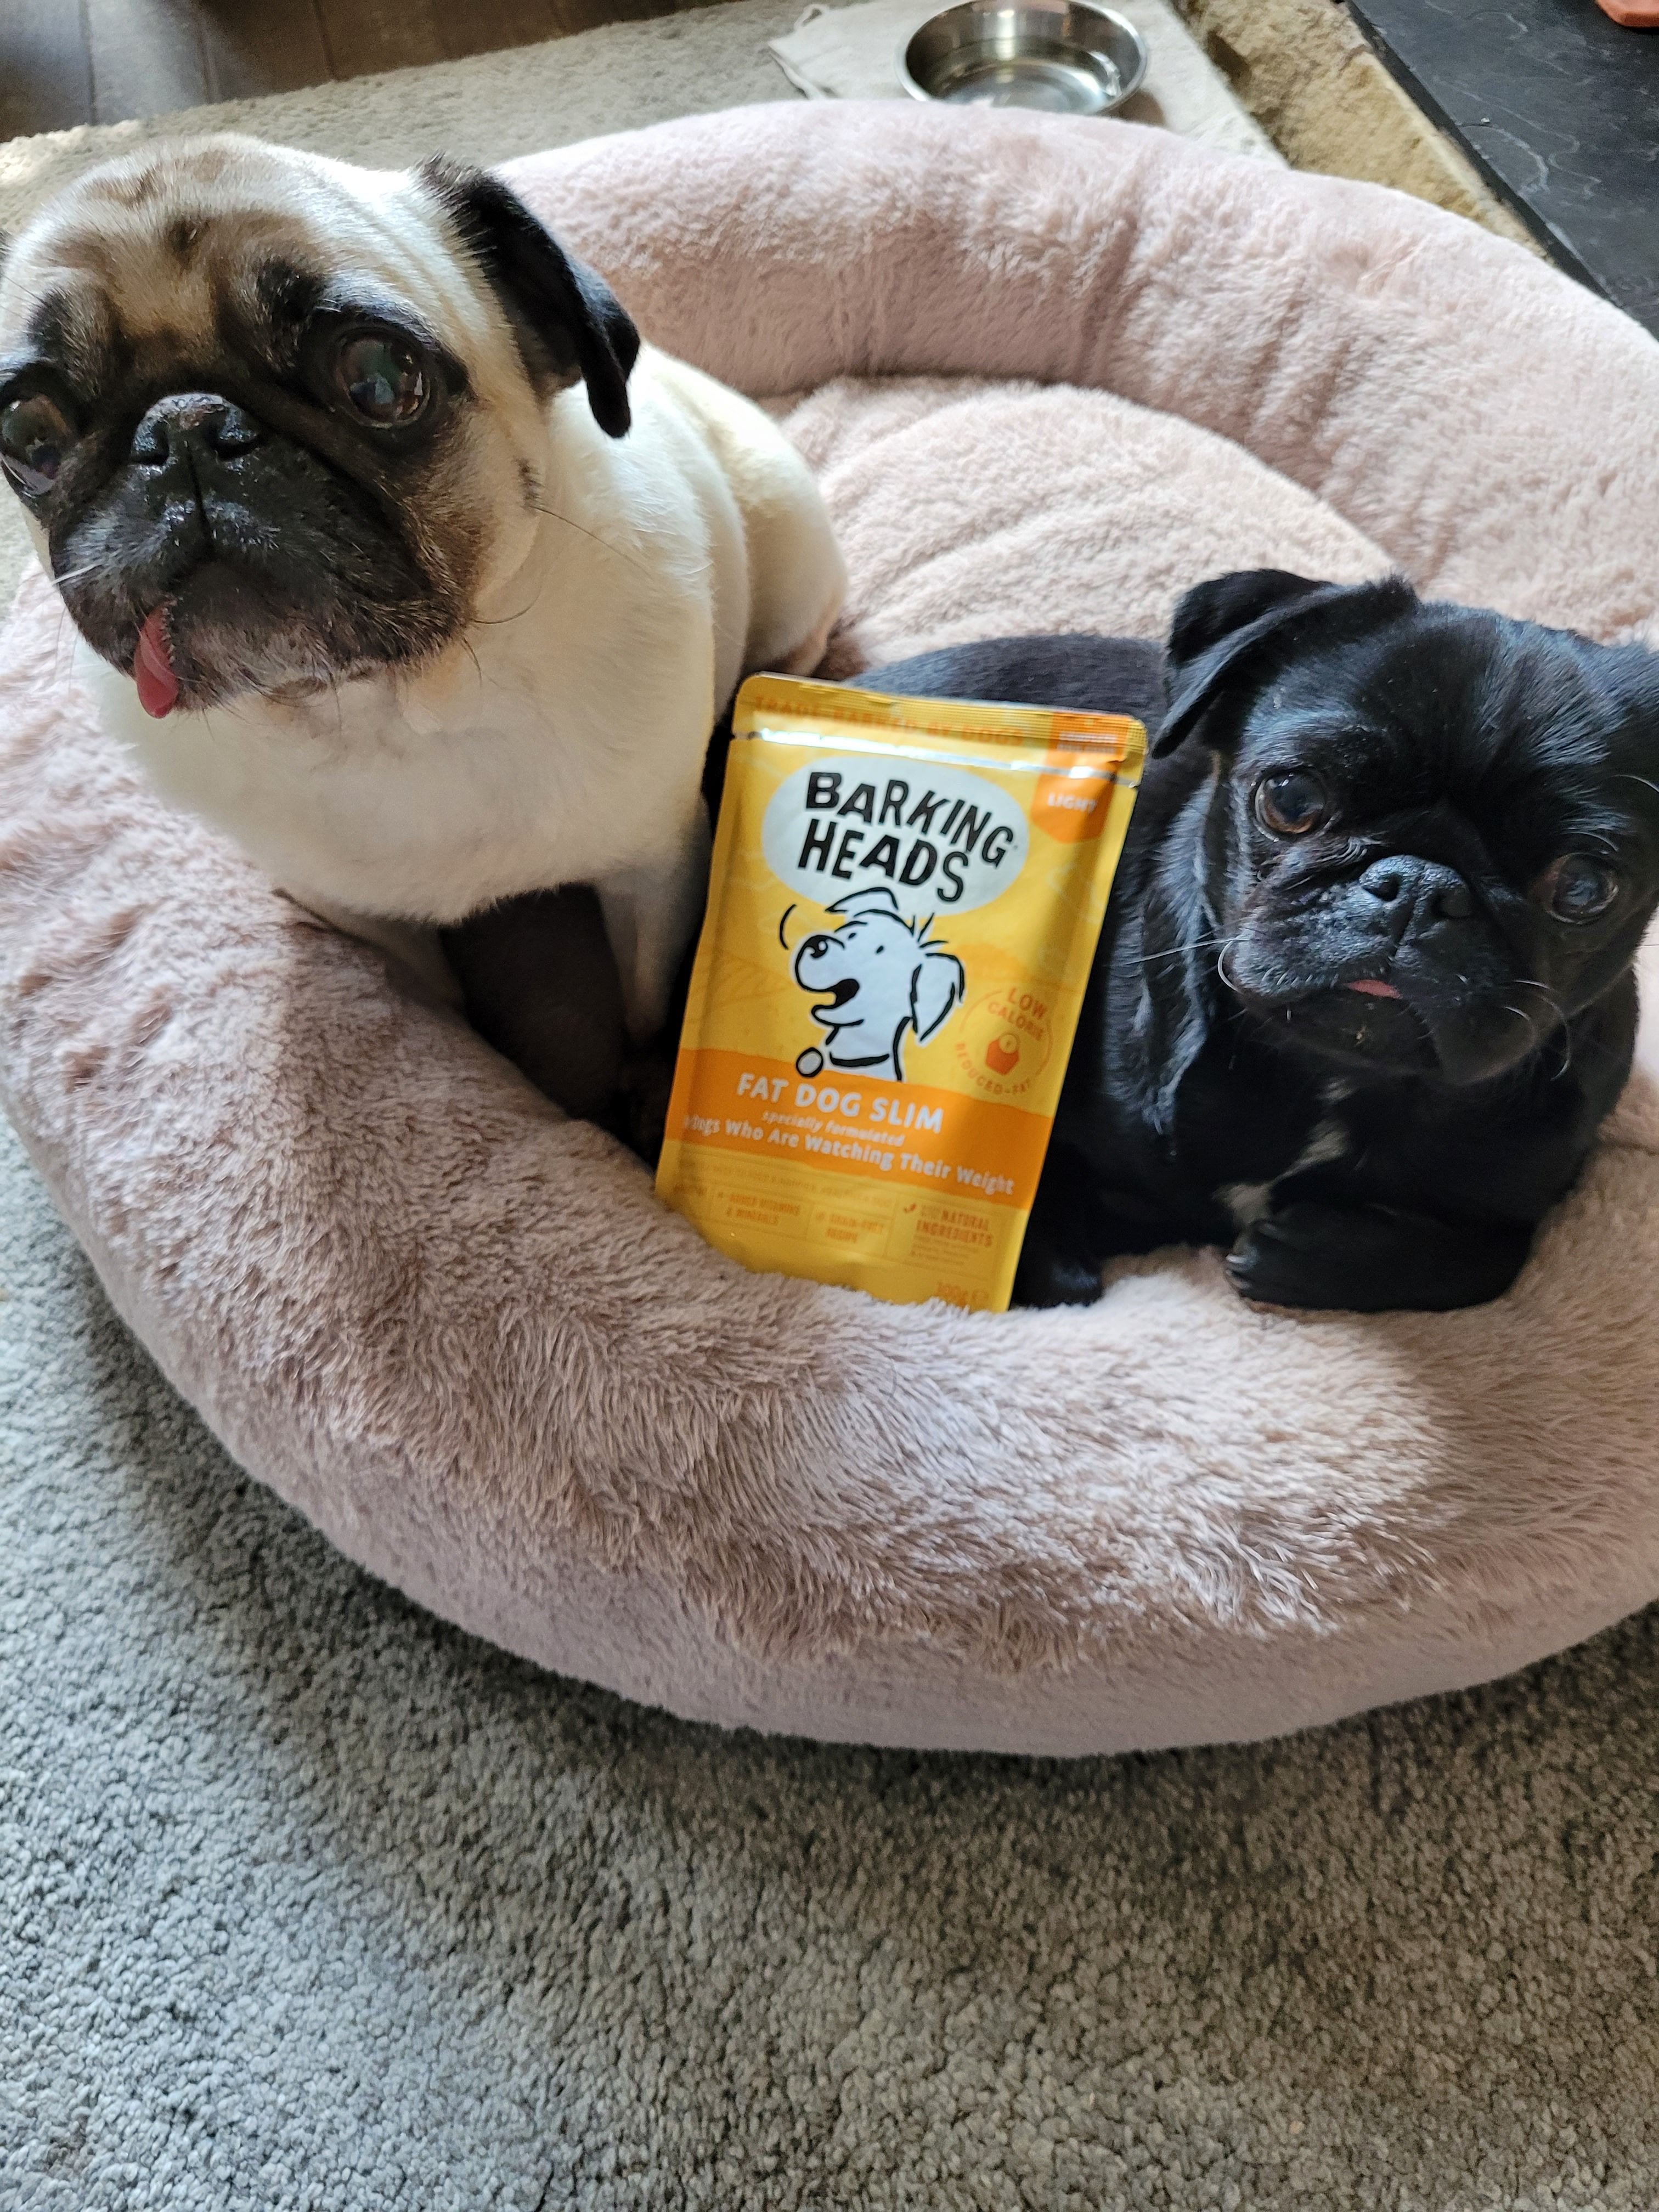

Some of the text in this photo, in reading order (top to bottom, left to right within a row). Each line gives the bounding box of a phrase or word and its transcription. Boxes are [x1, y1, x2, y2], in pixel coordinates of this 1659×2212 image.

[806, 772, 1014, 869] BARKING
[1047, 793, 1097, 814] LIGHT
[798, 819, 969, 902] HEADS
[1008, 987, 1047, 1020] LOW
[737, 1072, 944, 1134] FAT DOG SLIM
[763, 1110, 905, 1147] specially formulated
[725, 1118, 764, 1141] Who
[768, 1127, 799, 1147] Are
[805, 1133, 894, 1172] Watching
[900, 1152, 952, 1179] Their
[957, 1165, 1015, 1195] Weight
